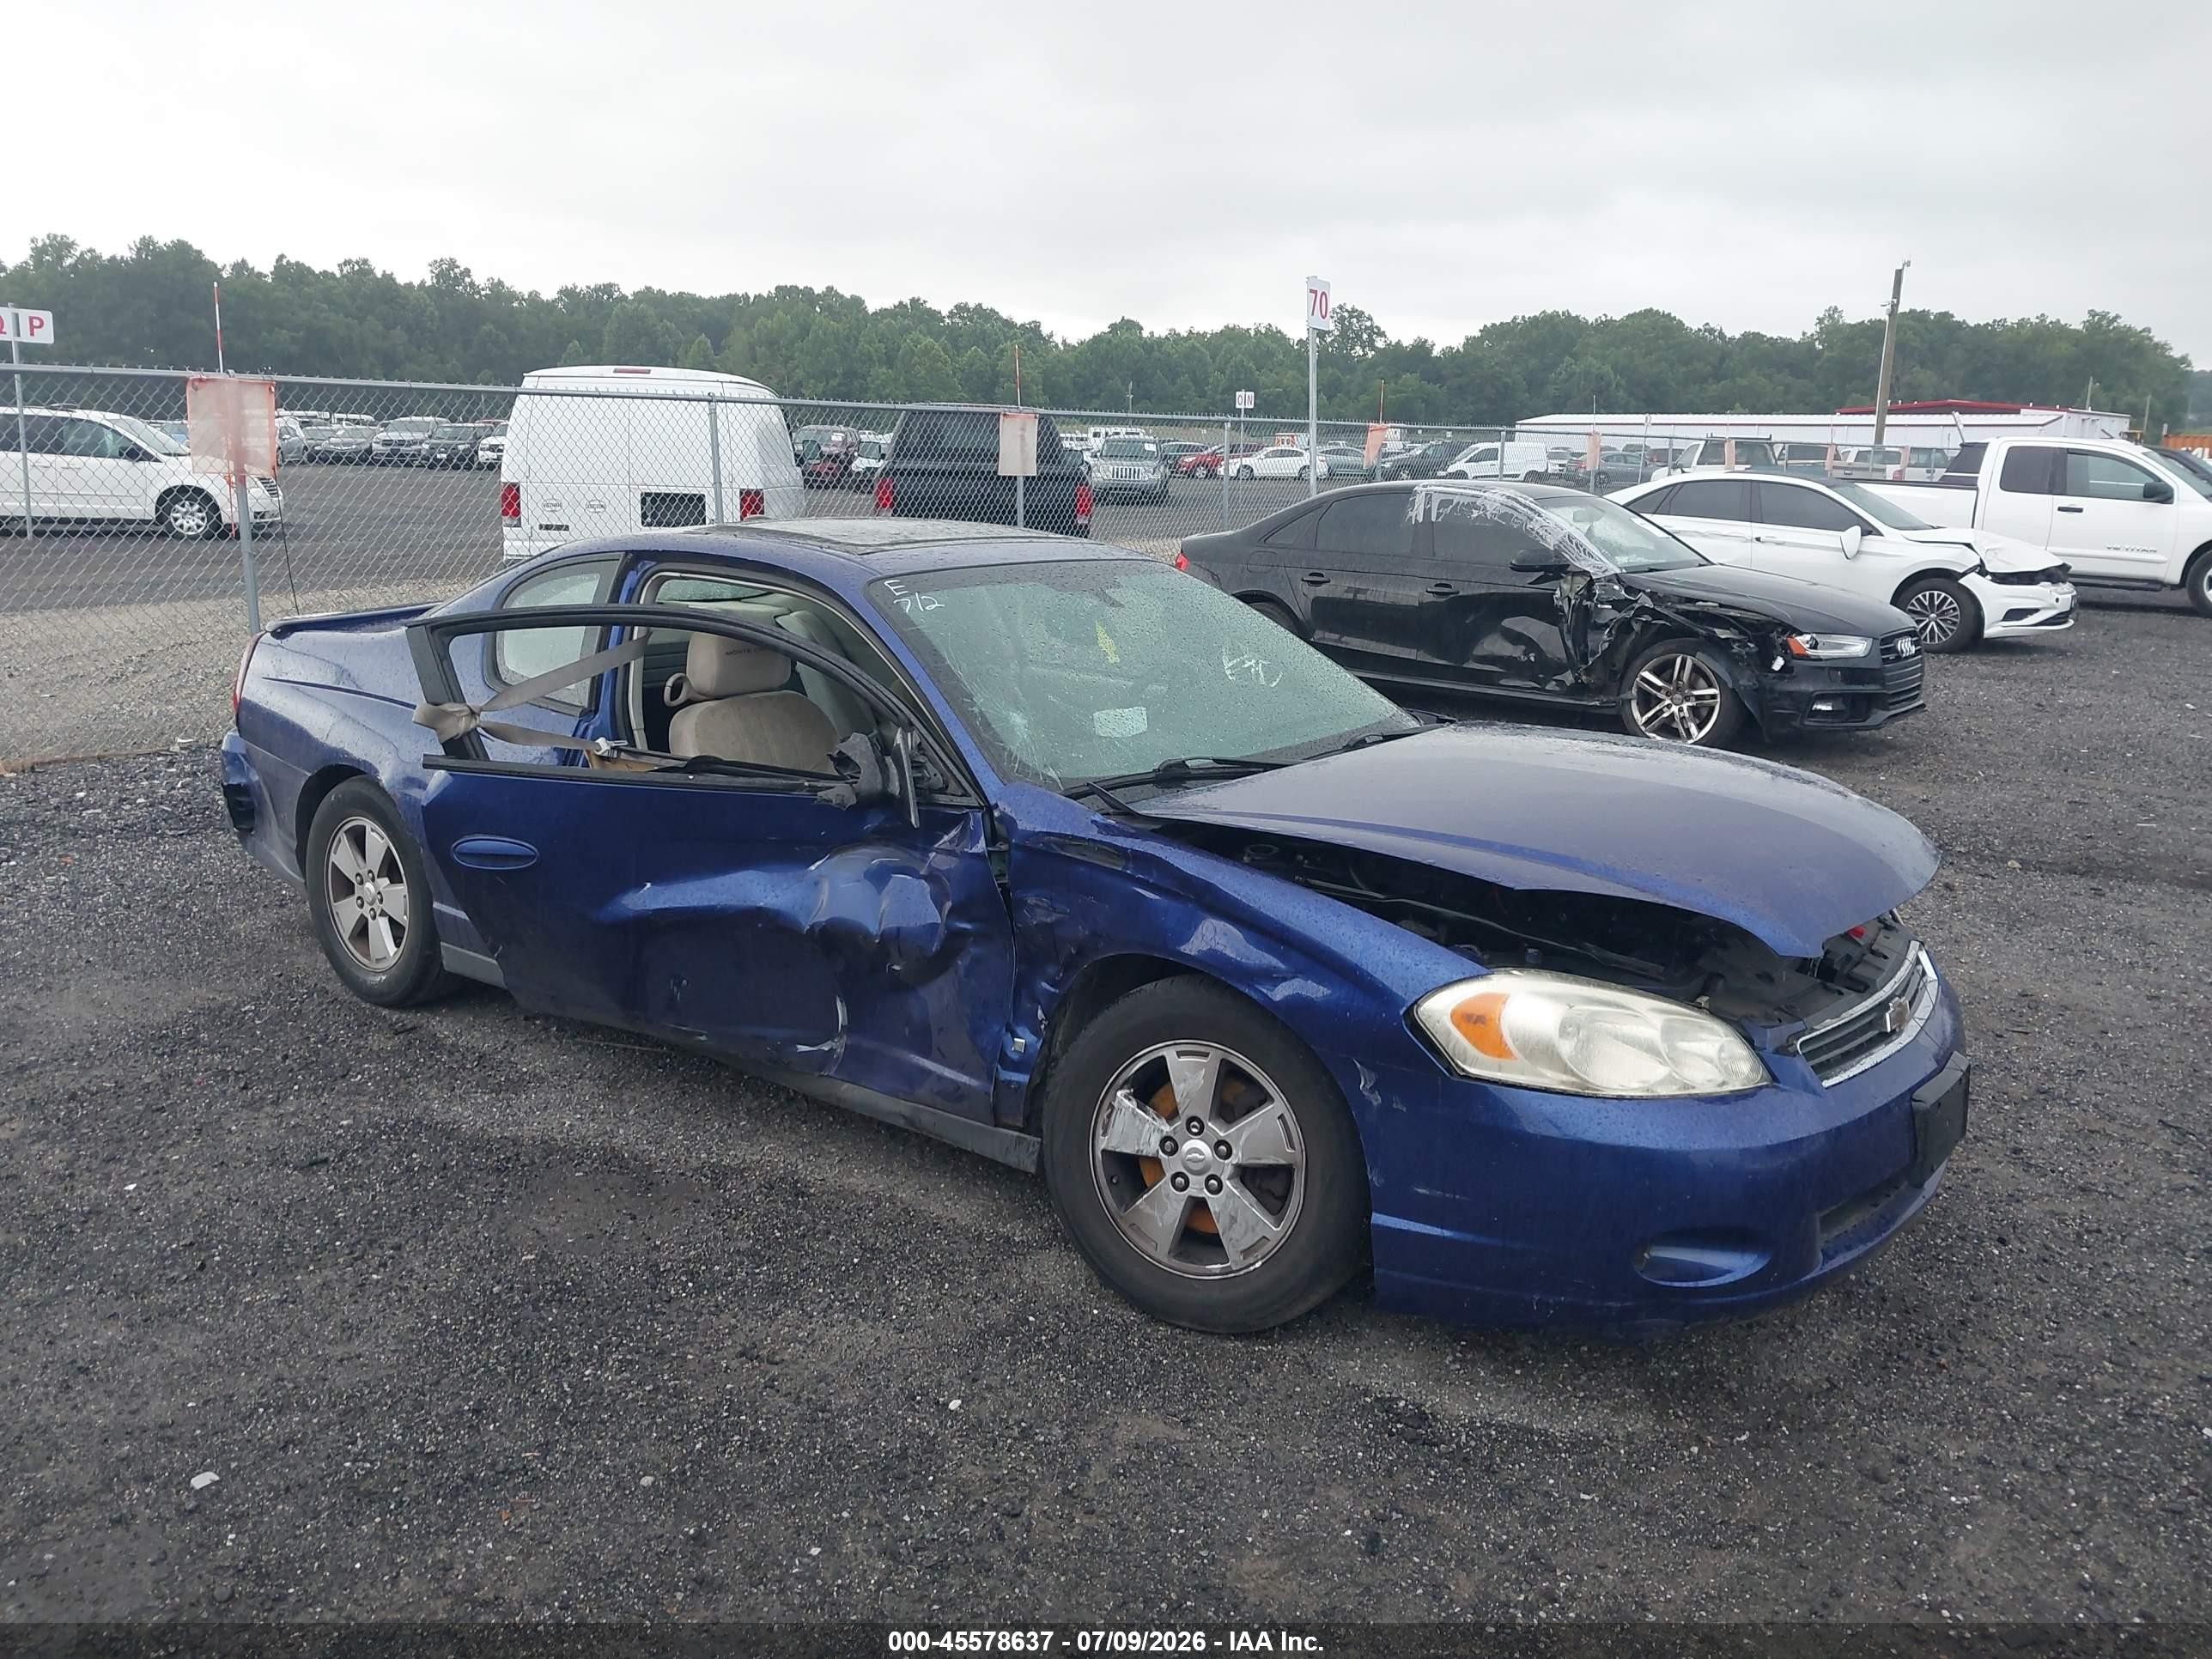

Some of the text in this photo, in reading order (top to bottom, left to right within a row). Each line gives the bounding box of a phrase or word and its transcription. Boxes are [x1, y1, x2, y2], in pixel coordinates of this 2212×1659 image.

[1310, 289, 1328, 319] 70
[29, 316, 45, 337] P
[884, 580, 908, 596] E
[893, 592, 945, 613] 712
